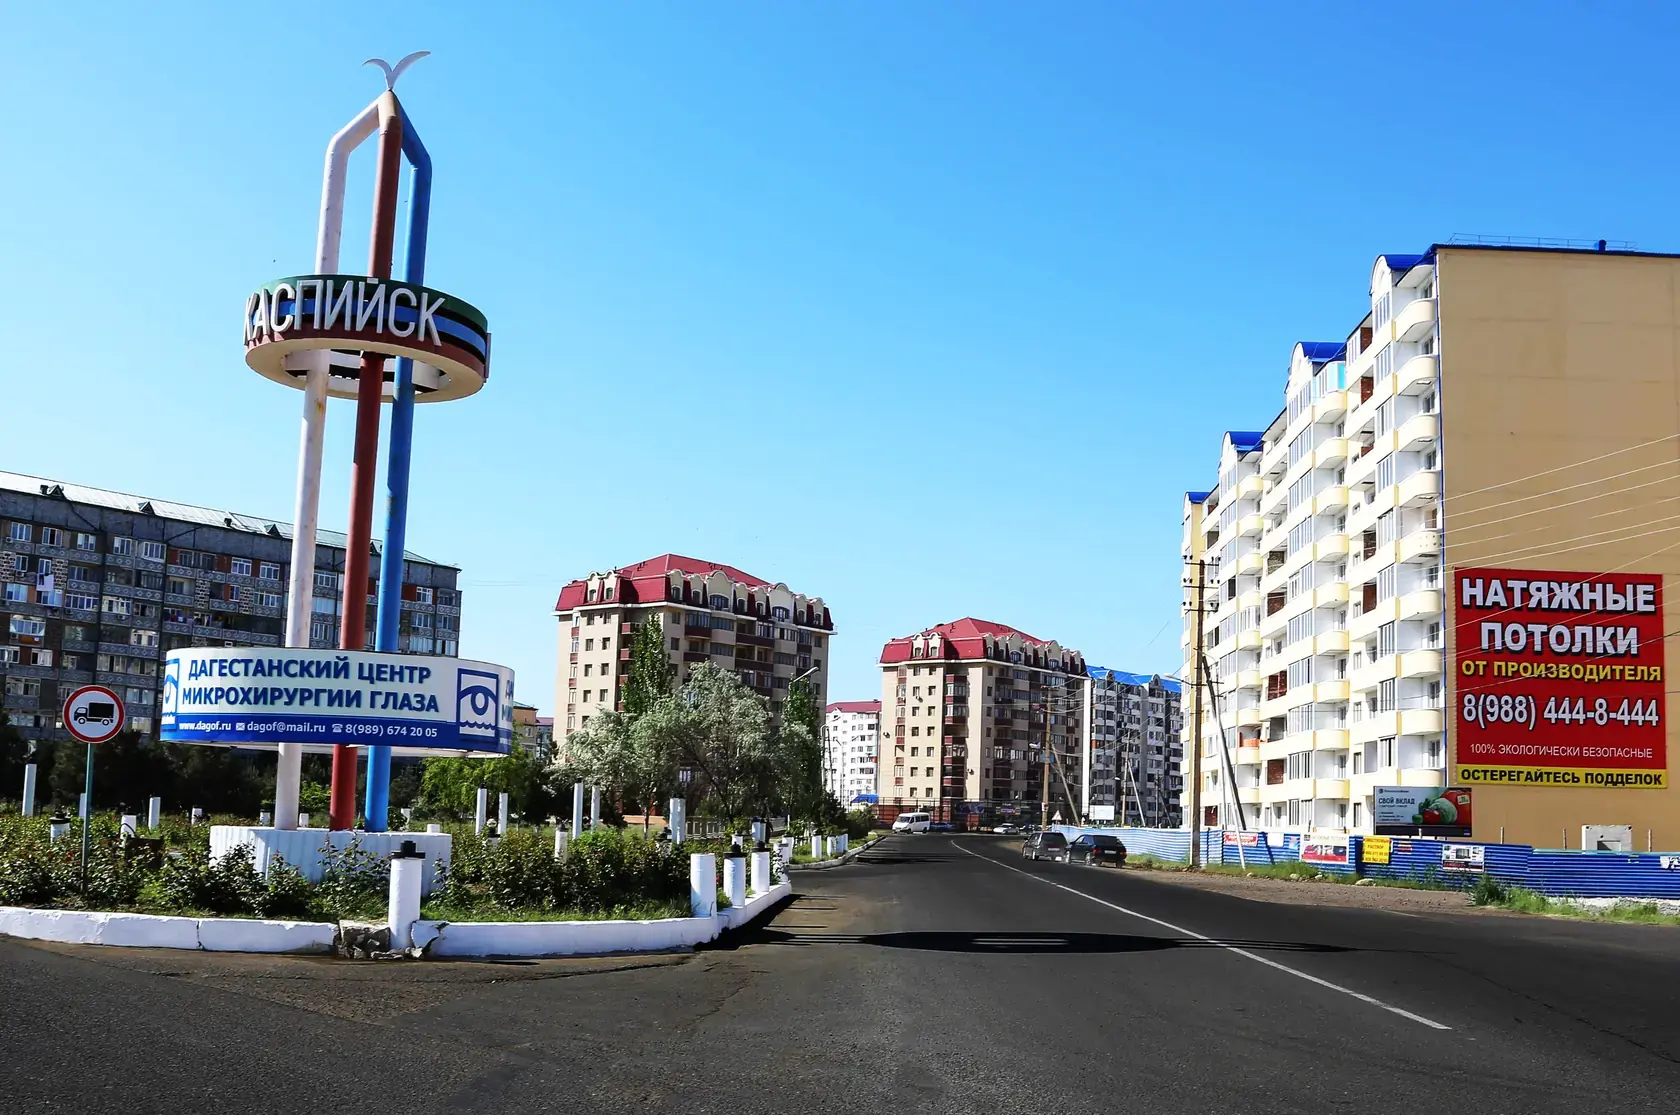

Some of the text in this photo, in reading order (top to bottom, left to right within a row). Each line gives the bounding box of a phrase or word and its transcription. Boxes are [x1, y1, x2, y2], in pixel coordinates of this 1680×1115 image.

[244, 277, 445, 346] КАСПИЙСК
[1462, 578, 1656, 613] НАТЯЖНЫЕ
[1480, 622, 1639, 655] ПОТОЛКИ
[188, 655, 431, 685] ДАГЕСТАНСКИЙ ЦЕНТР
[1461, 660, 1662, 682] ОТ ПРОИЗВОДИТЕЛЯ
[182, 686, 439, 713] МИКРОХИРУРГИИ ГЛАЗА
[1463, 693, 1659, 730] 8(988) 444-8-444
[179, 720, 232, 731] www.dagof.ru
[247, 721, 326, 733] dagof@mail.ru
[345, 723, 438, 737] 8(989) 674 20 05
[1470, 743, 1653, 758] 100% ЭКОЛОГИЧЕСКИ БЕЗОПАСНЫЕ
[1461, 768, 1663, 787] ОСТЕРЕГАЙТЕСЬ ПОДДЕЛОК
[1378, 797, 1415, 805] СВОЙ ВКЛАД
